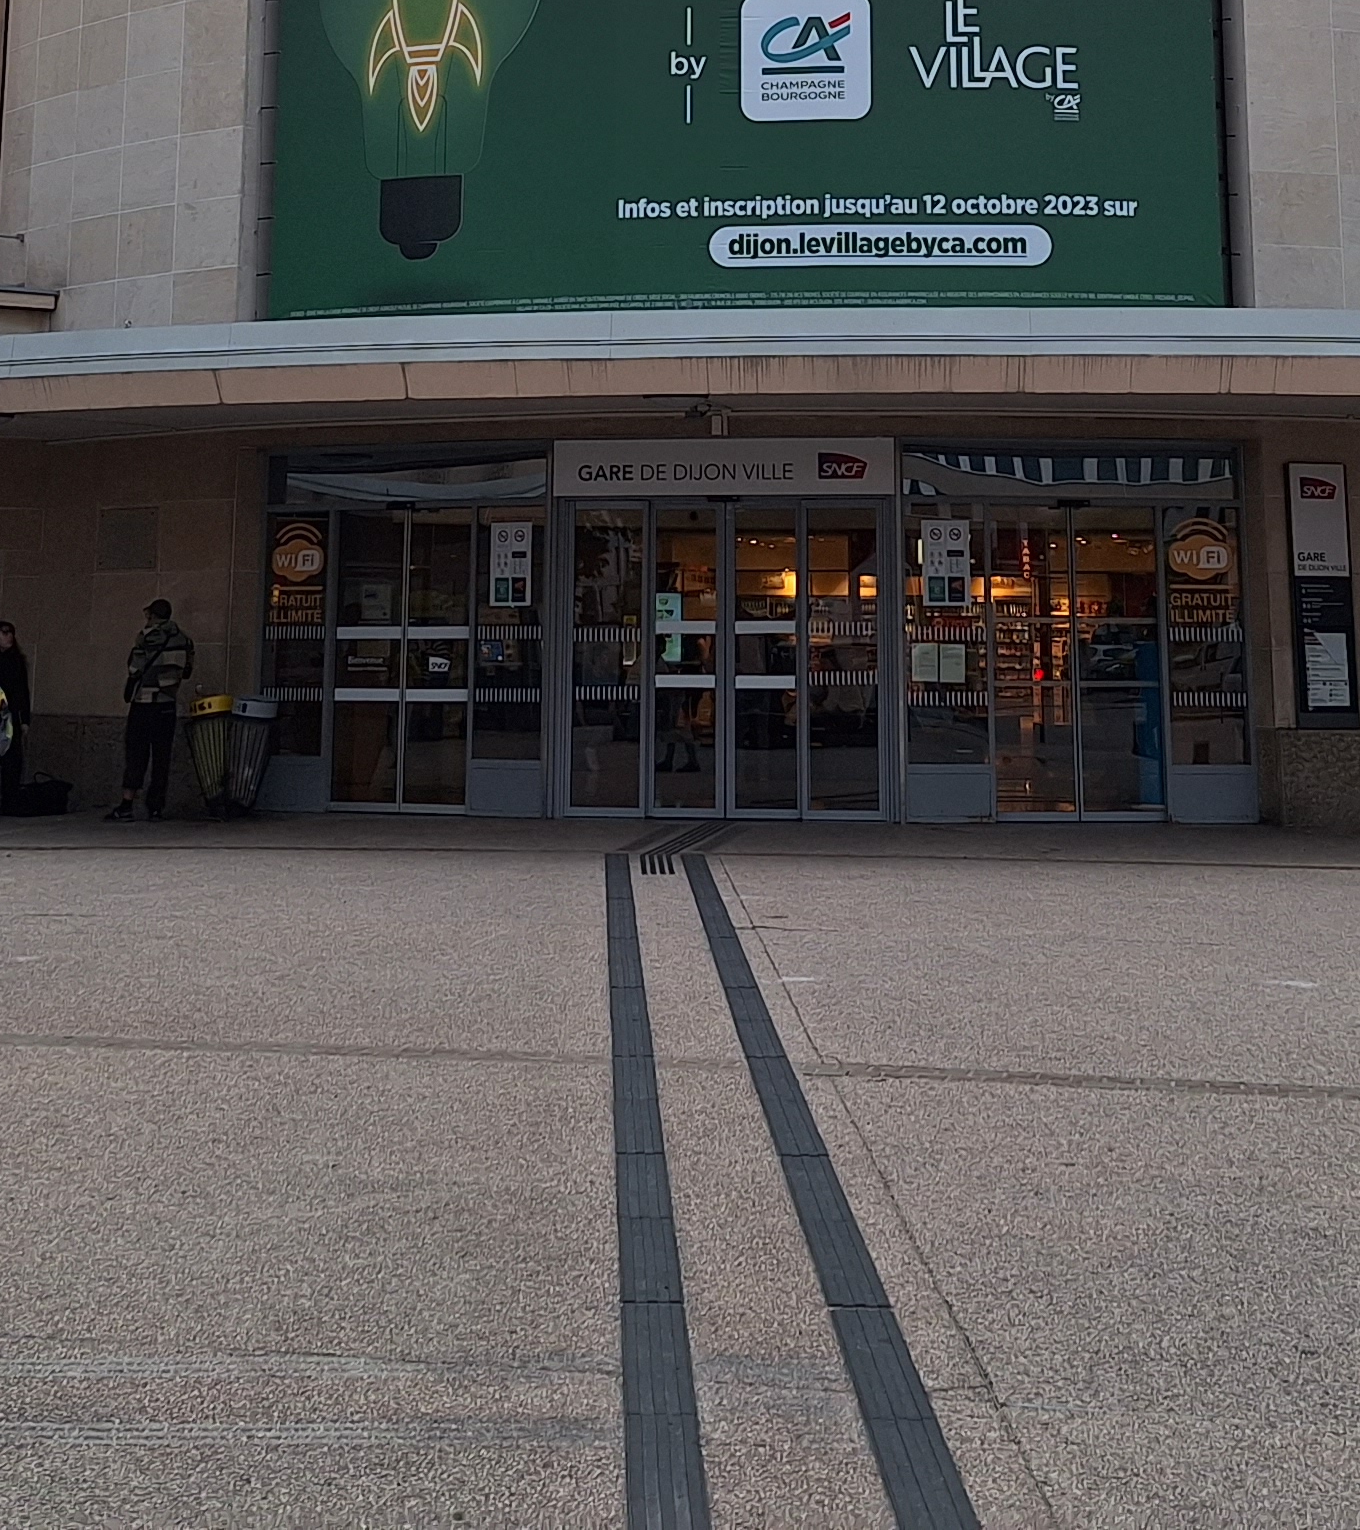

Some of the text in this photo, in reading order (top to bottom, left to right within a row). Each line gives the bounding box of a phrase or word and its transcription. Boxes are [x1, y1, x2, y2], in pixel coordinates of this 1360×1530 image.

[760, 11, 851, 64] CA
[669, 52, 706, 79] by
[909, 36, 1079, 90] VILLAGE
[760, 79, 846, 90] CHAMPAGNE
[761, 90, 846, 102] BOURGOGNE
[618, 194, 1138, 219] Infos et inscription jusqu'au 12 octobre 2023 sur
[728, 232, 1027, 258] dijon.levillagebyca.com
[578, 463, 794, 482] GARE DE DIJON VILLE
[820, 461, 865, 476] SNCF
[1302, 485, 1334, 497] SNCF
[1297, 551, 1326, 562] GARE
[270, 595, 322, 607] GRATUIT
[1170, 592, 1234, 606] GRATUIT
